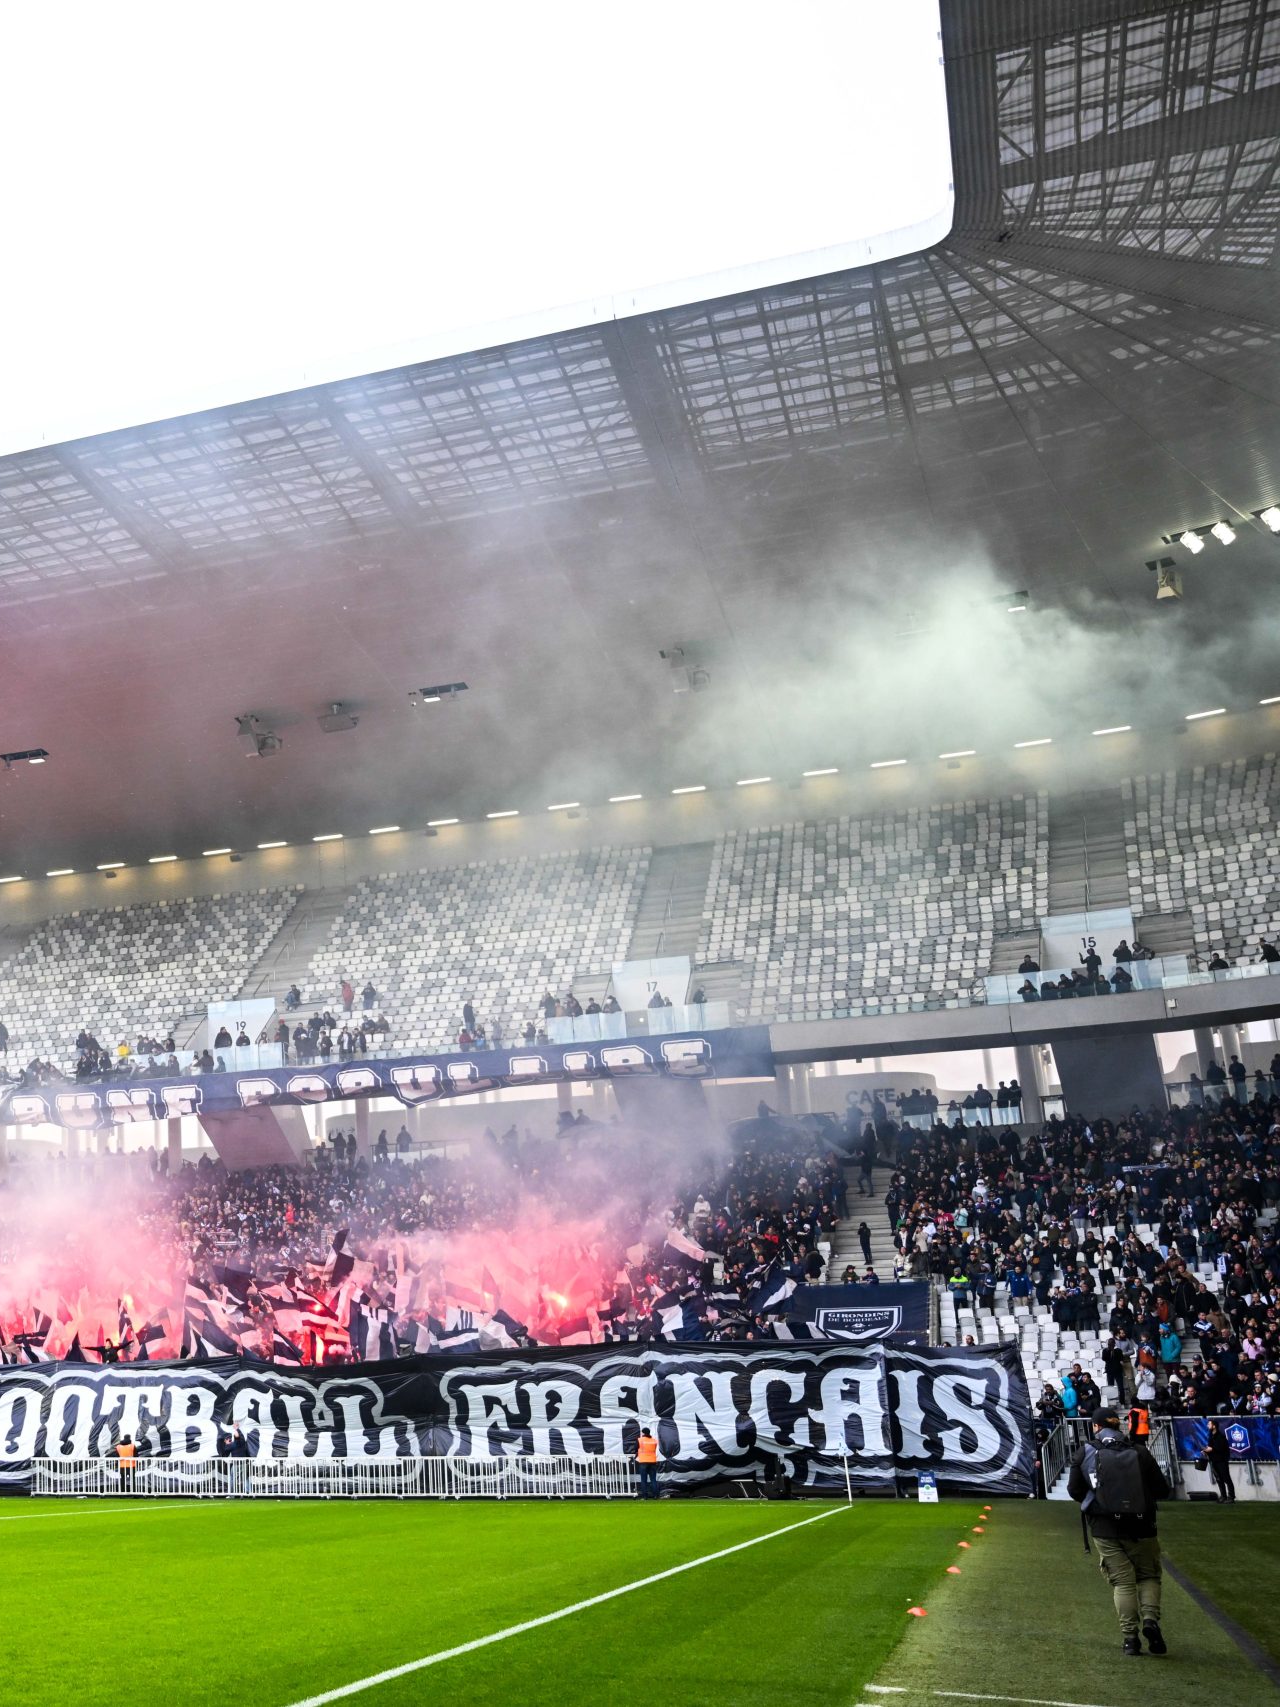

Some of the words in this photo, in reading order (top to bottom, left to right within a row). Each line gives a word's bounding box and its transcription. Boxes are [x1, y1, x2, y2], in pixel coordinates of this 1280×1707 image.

[1081, 936, 1097, 949] 15
[646, 981, 658, 993] 17
[235, 1021, 247, 1031] 19
[828, 1311, 890, 1319] GIRONDINS
[843, 1315, 889, 1323] BORDEAUX
[459, 1364, 1010, 1478] FRANÇAIS
